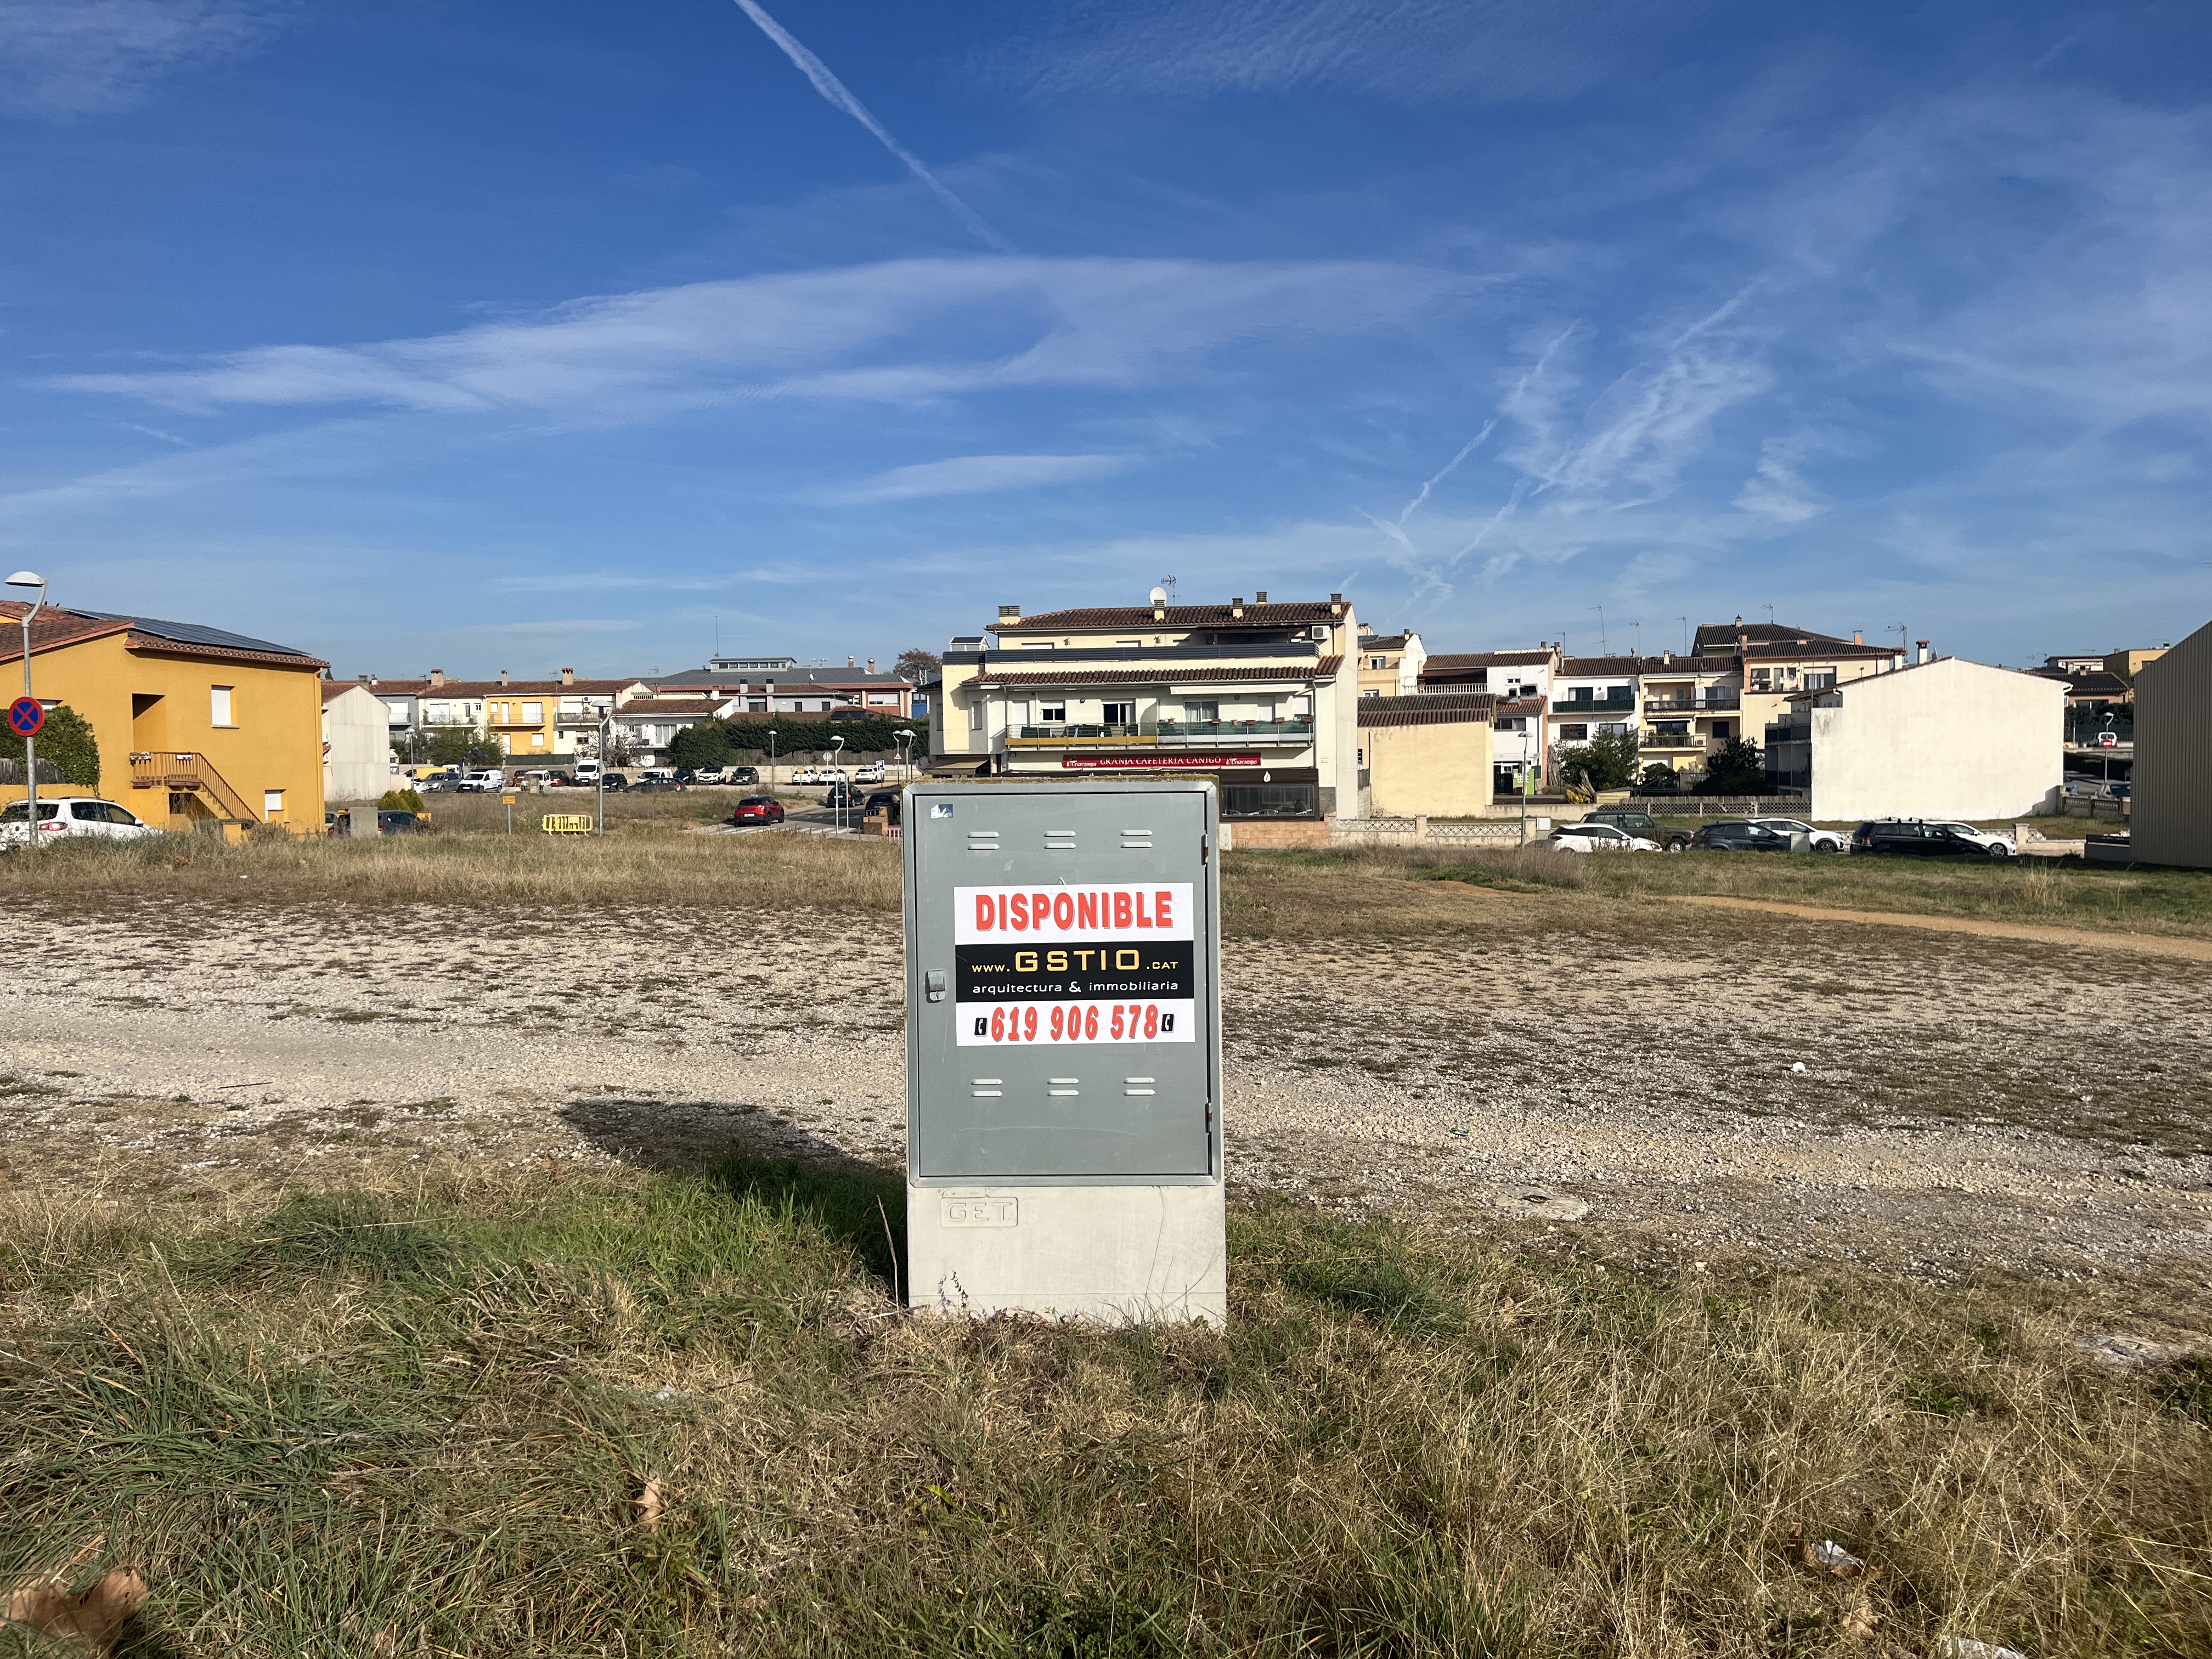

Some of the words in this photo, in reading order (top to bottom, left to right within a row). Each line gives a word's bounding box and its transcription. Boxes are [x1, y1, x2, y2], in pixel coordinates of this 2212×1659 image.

[1186, 755, 1221, 764] CANIGÓ
[975, 891, 1173, 931] DISPONIBLE
[973, 984, 1062, 995] arquitectura
[1069, 981, 1081, 992] &
[1089, 981, 1178, 991] immobiliaria
[991, 1007, 1038, 1041] 619
[1050, 1005, 1098, 1041] 906
[1110, 1005, 1158, 1040] 578
[947, 1201, 1012, 1222] GET
